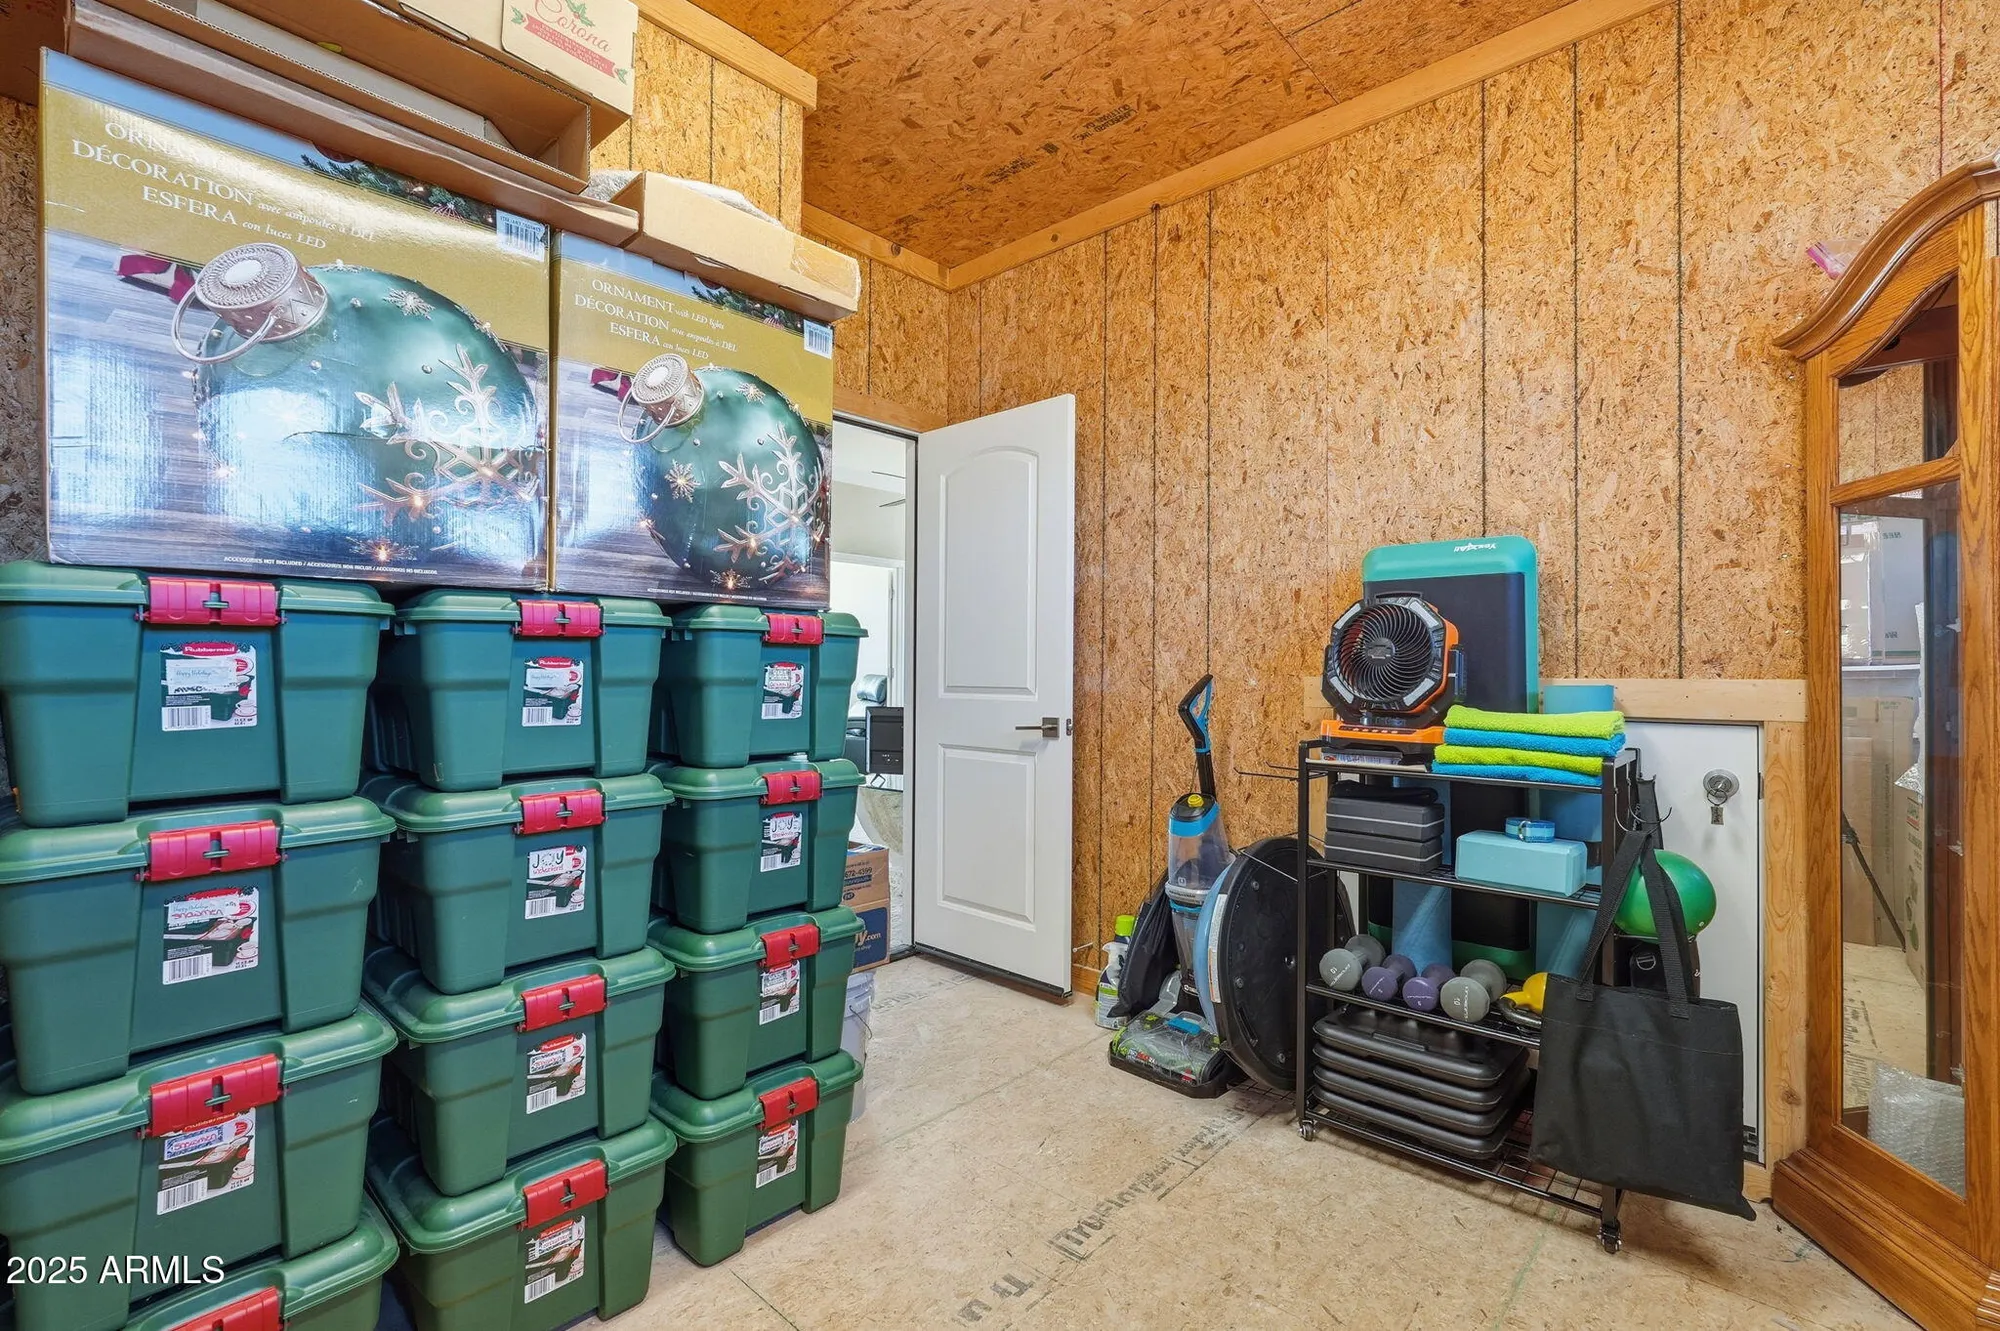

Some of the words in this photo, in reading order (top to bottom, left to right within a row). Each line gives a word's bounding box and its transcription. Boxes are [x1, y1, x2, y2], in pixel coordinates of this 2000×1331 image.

[72, 138, 254, 205] DÉCORATION
[142, 185, 237, 225] ESFERA
[242, 221, 261, 232] con
[266, 224, 292, 240] luces
[296, 233, 326, 249] LED
[574, 293, 670, 331] DÉCORATION
[721, 341, 738, 353] DEL
[592, 279, 675, 313] ORNAMENT
[691, 313, 708, 325] LED
[610, 322, 661, 347] ESFERA
[692, 348, 709, 360] LED
[855, 929, 881, 947] y.com
